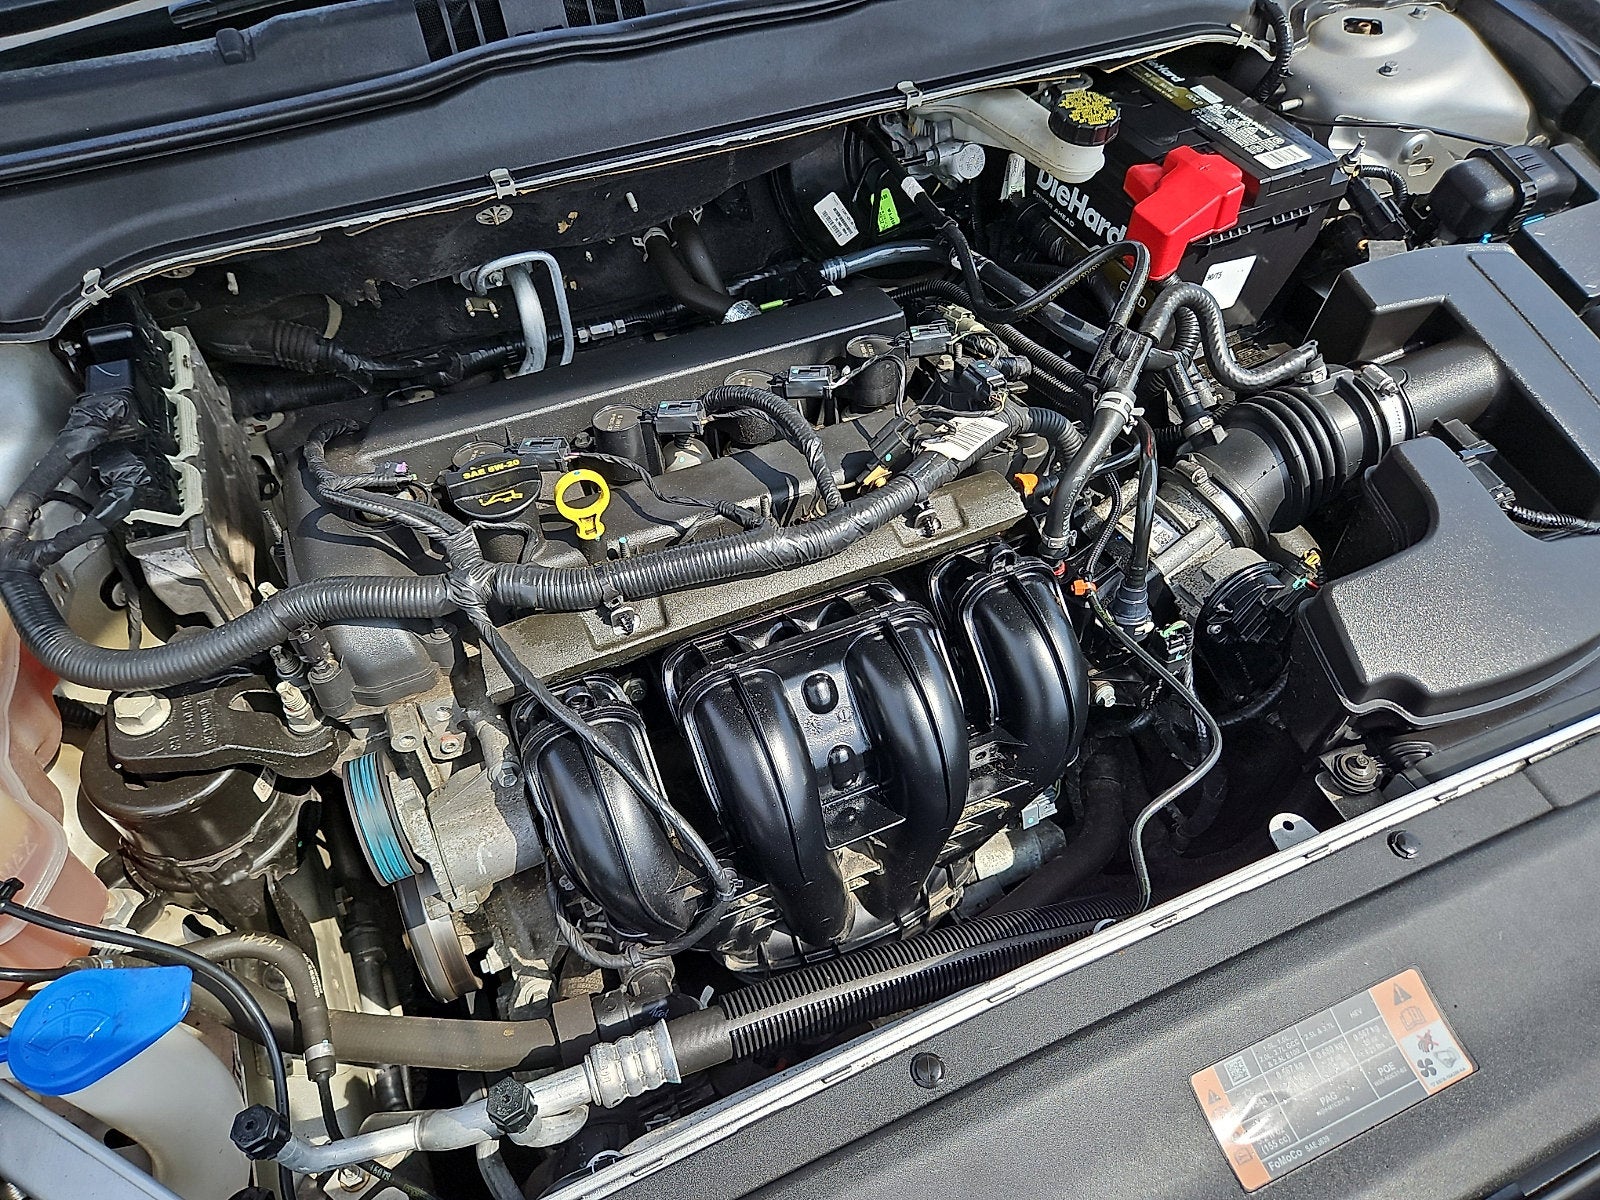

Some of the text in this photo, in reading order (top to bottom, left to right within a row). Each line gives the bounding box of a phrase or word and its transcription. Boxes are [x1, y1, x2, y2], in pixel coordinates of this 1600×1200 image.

[1036, 169, 1127, 244] DieHard
[1053, 207, 1075, 228] AHEAD
[462, 459, 520, 480] SAE 5W-20
[1376, 1061, 1396, 1076] POE
[1319, 1090, 1338, 1106] PAG
[1267, 1146, 1303, 1172] FoMoCo
